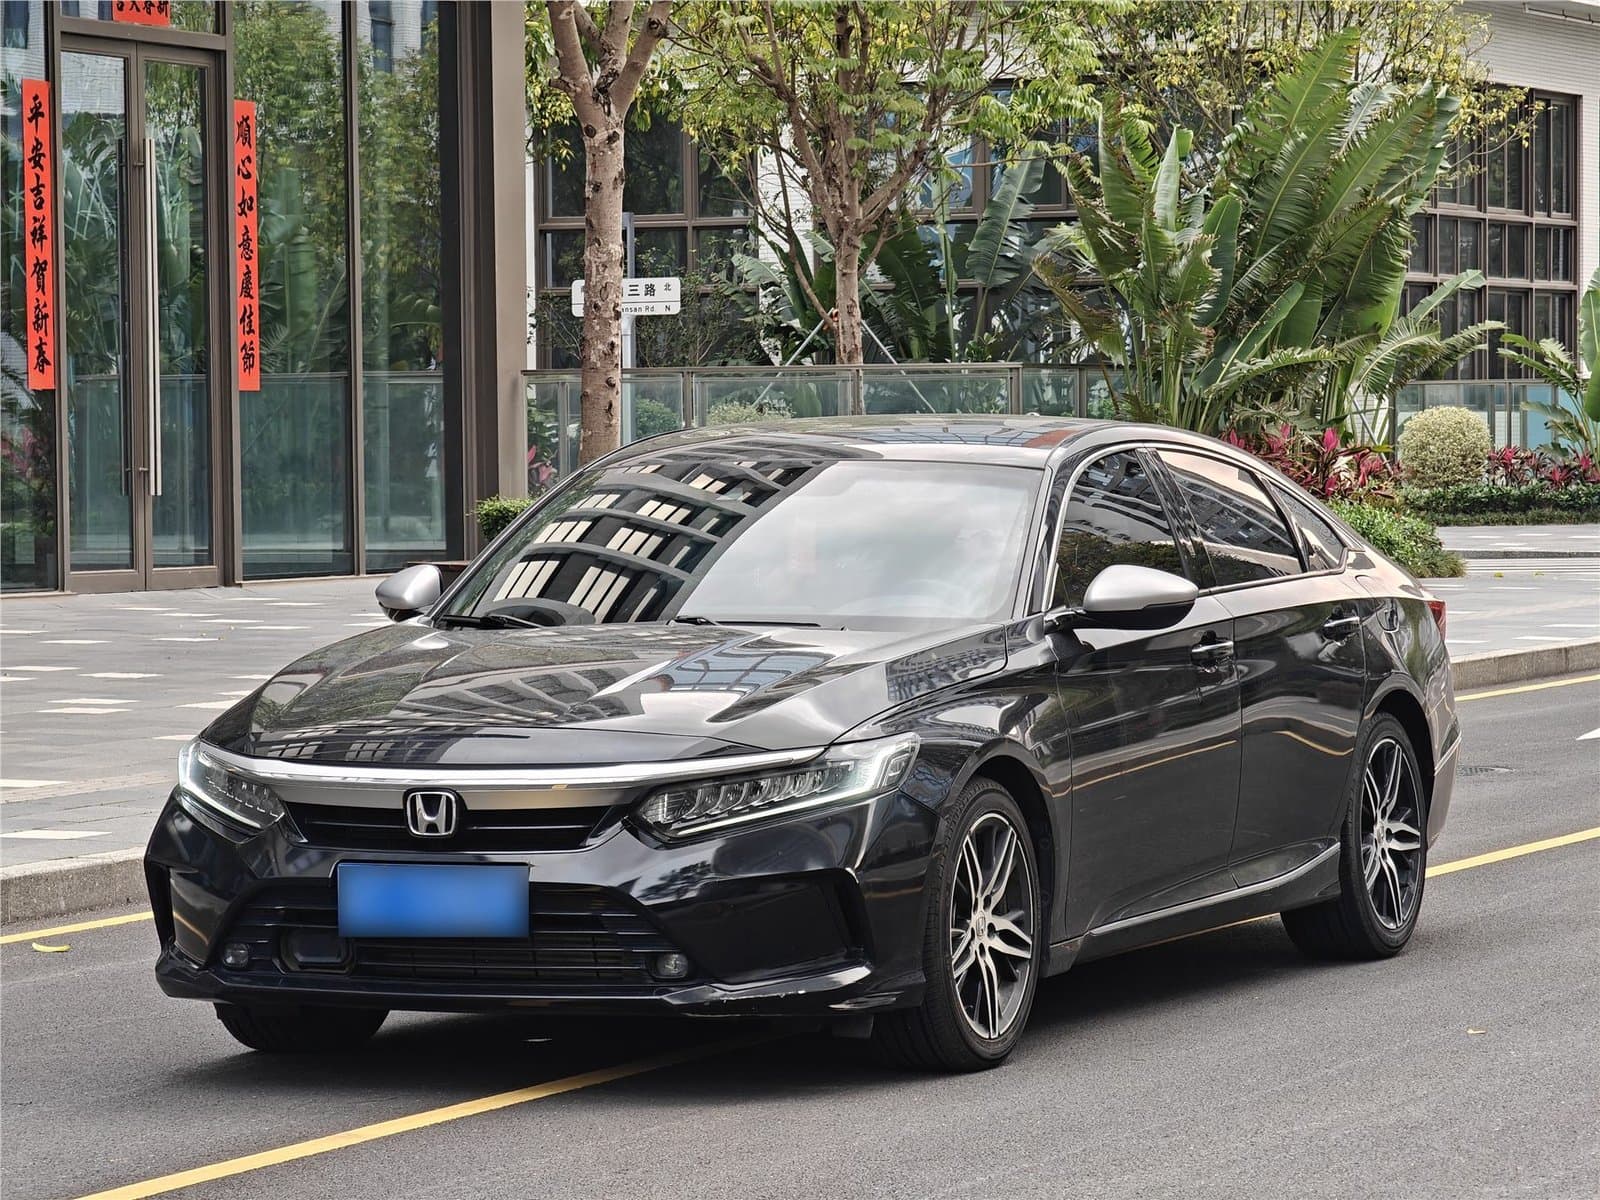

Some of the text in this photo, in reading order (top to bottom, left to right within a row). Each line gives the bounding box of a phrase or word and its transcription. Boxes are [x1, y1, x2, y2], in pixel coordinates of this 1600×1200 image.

[664, 282, 672, 292] 北
[644, 304, 655, 313] Rd
[664, 304, 671, 312] N
